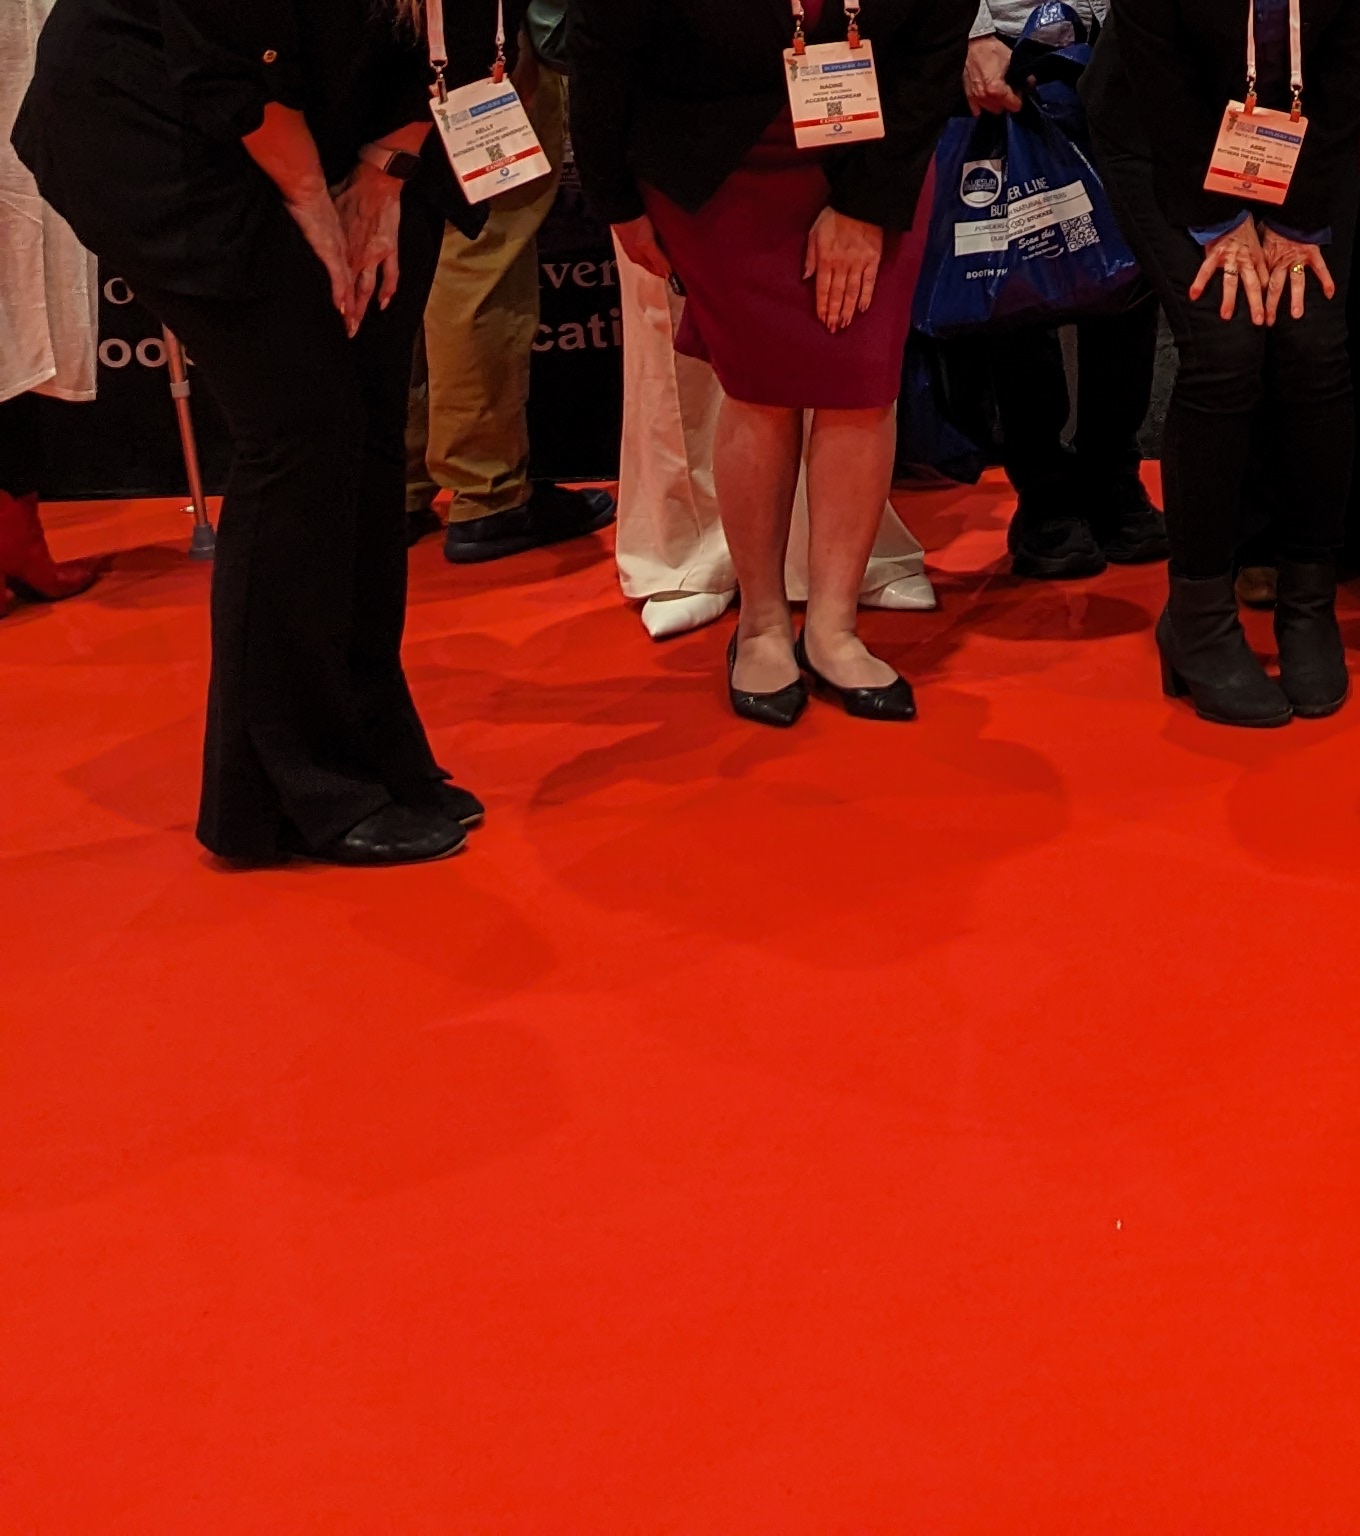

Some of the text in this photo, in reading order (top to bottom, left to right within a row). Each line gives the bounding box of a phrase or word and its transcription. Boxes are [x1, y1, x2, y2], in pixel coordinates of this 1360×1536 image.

[1024, 176, 1050, 194] LINE
[1018, 227, 1056, 250] Scan this
[541, 260, 617, 290] ver
[966, 268, 995, 280] BOOTH
[531, 307, 621, 352] cati
